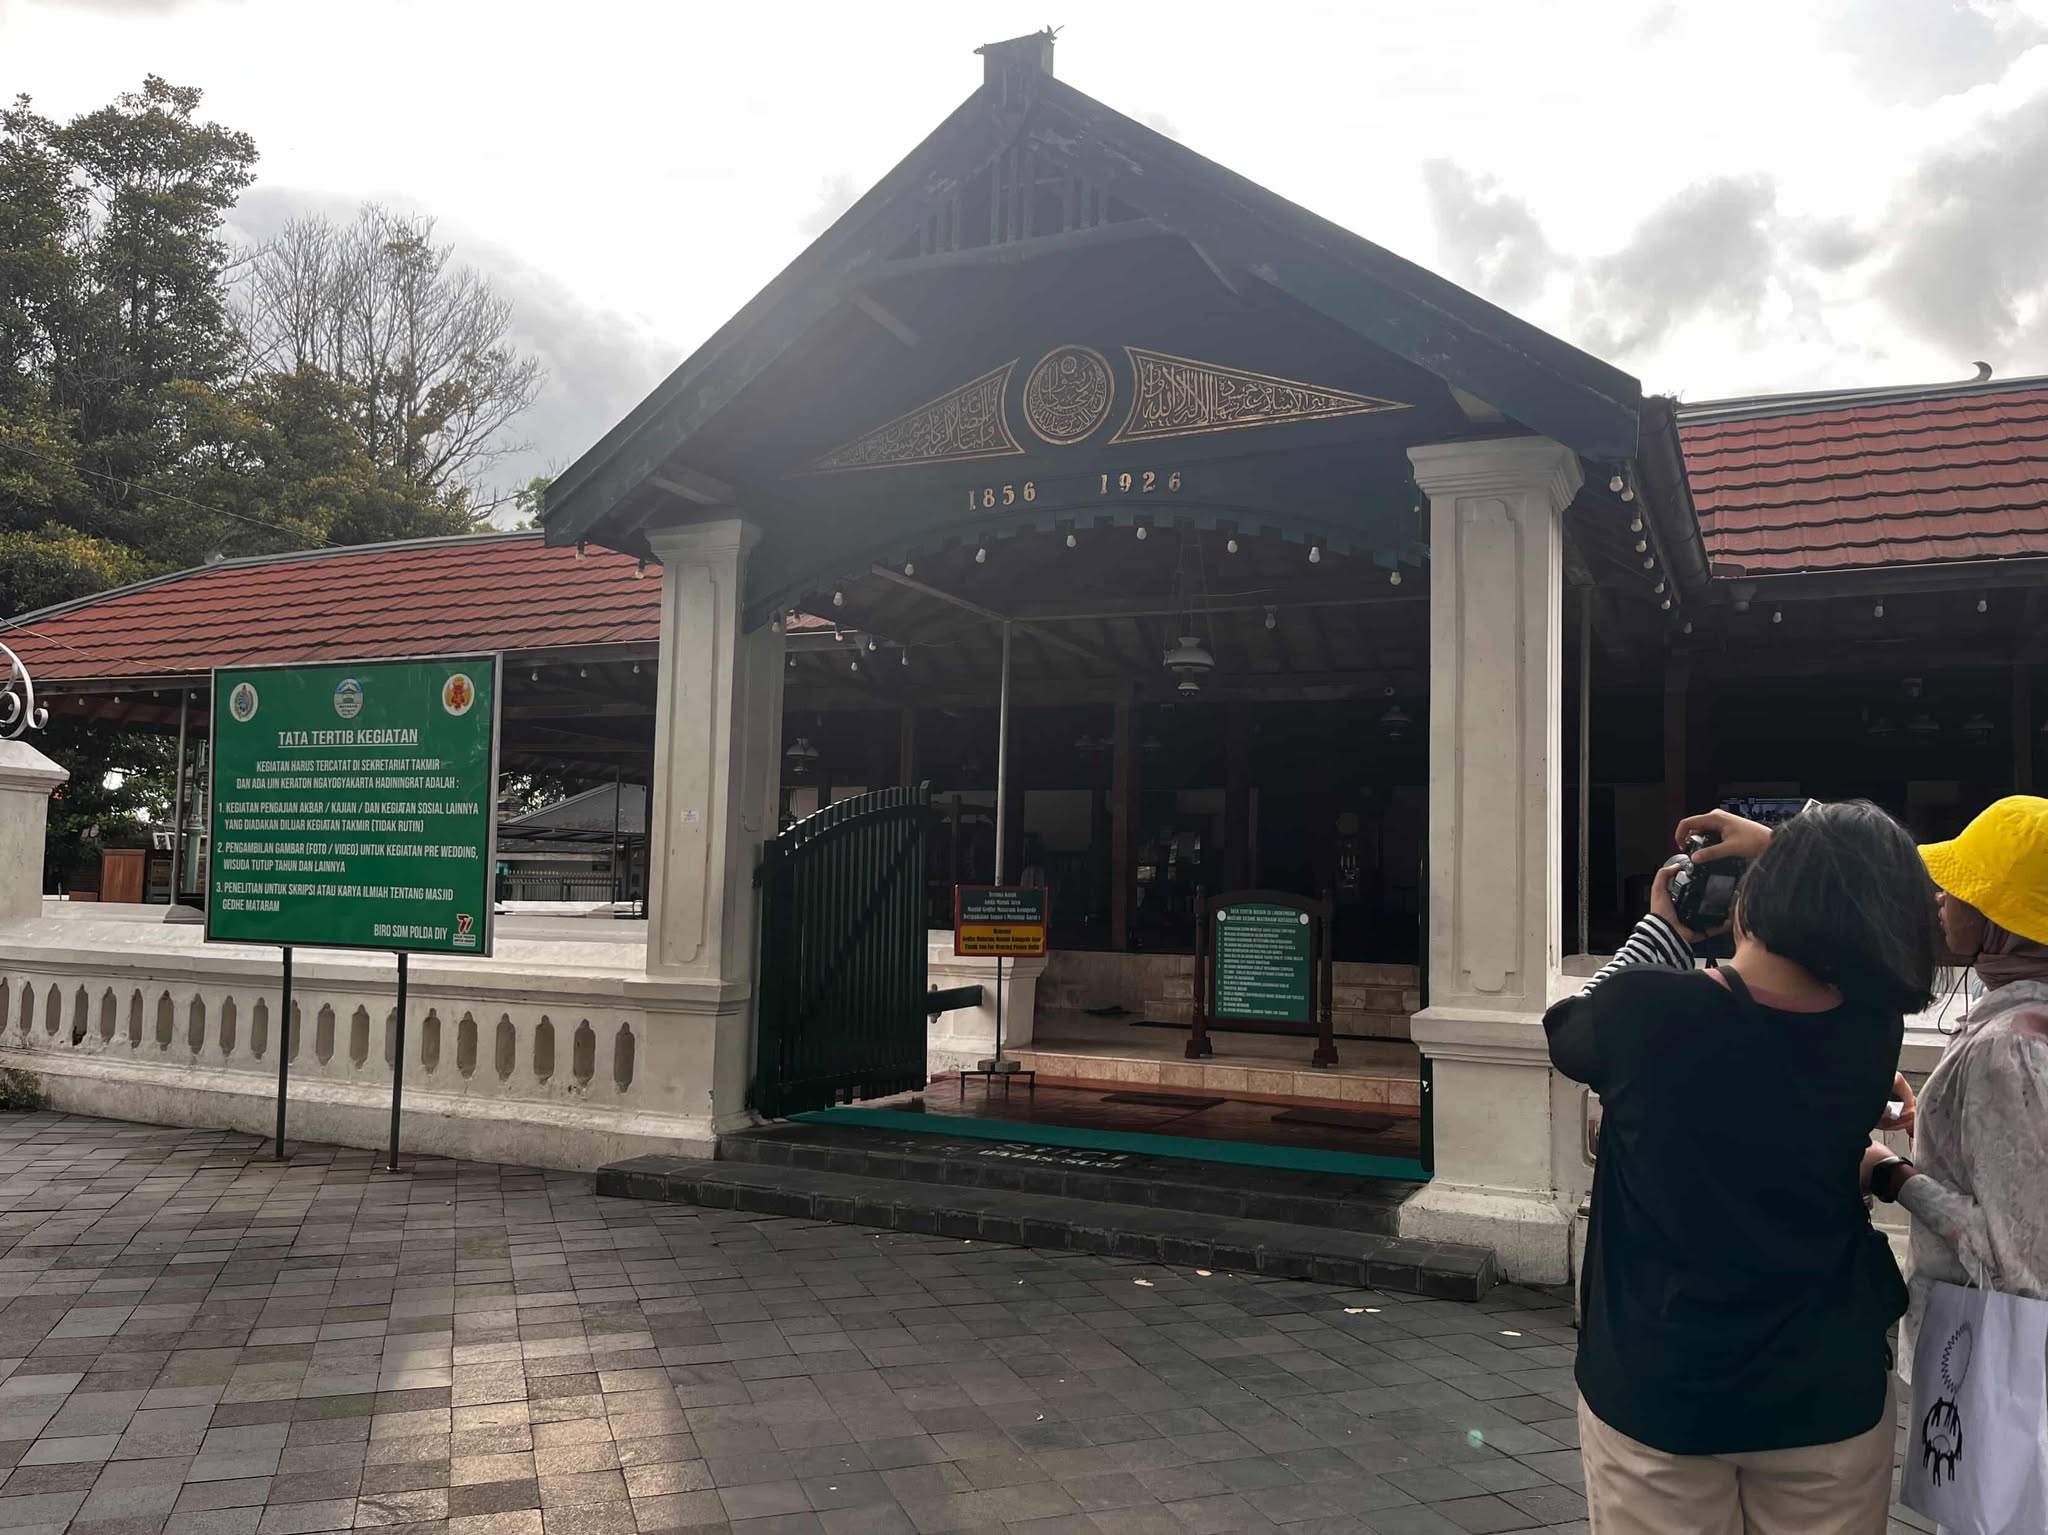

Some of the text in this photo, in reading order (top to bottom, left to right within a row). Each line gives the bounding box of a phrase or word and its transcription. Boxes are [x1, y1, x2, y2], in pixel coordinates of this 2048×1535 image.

[1101, 471, 1182, 495] 1926
[968, 481, 1036, 511] 1856
[278, 729, 418, 745] TATA TERTIB KEGIATAN
[256, 759, 440, 772] KEGIATAN HARUS TERCATAT DI SEKRETARIAT TAKMIR
[236, 778, 251, 789] DAN
[252, 778, 266, 789] ADA
[281, 778, 312, 789] KERATON
[313, 777, 374, 789] NGAYOGYAKARTA
[375, 777, 424, 789] HADININGRAT
[425, 777, 455, 788] ADALAH
[218, 803, 225, 814] 1.
[226, 802, 259, 814] KEGIATAN
[260, 802, 298, 814] PENGAJIAN
[299, 802, 324, 814] AKBAR
[331, 802, 357, 813] KAJIAN
[364, 802, 380, 814] DAN
[381, 802, 416, 814] KEGIATAN
[417, 803, 444, 815] SOSIAL
[446, 803, 479, 815] LAINNYA
[225, 819, 424, 832] YANG DIADAKAN DILUAR KEGIATAN TAKMIR (TIDAK RUTIN)
[217, 842, 224, 853] 2.
[225, 842, 274, 854] PENGAMBILAN
[275, 843, 304, 854] GAMBAR
[306, 843, 327, 855] (FOTO
[335, 843, 359, 856] VIDEO)
[360, 844, 385, 856] UNTUK
[386, 844, 422, 857] KEGIATAN
[424, 845, 439, 857] PRE
[441, 846, 479, 859] WEDDING,
[223, 859, 345, 873] WISUDA TUTUP TAHUN DAN LAINNYA
[216, 882, 454, 901] 3. PENELITIAN UNTUK SKRIPSI ATAU KARYA ILMIAH TENTANG MASJID
[222, 899, 280, 912] GEDHE MATARAM
[374, 924, 448, 940] BIRO SDM POLDA DIY
